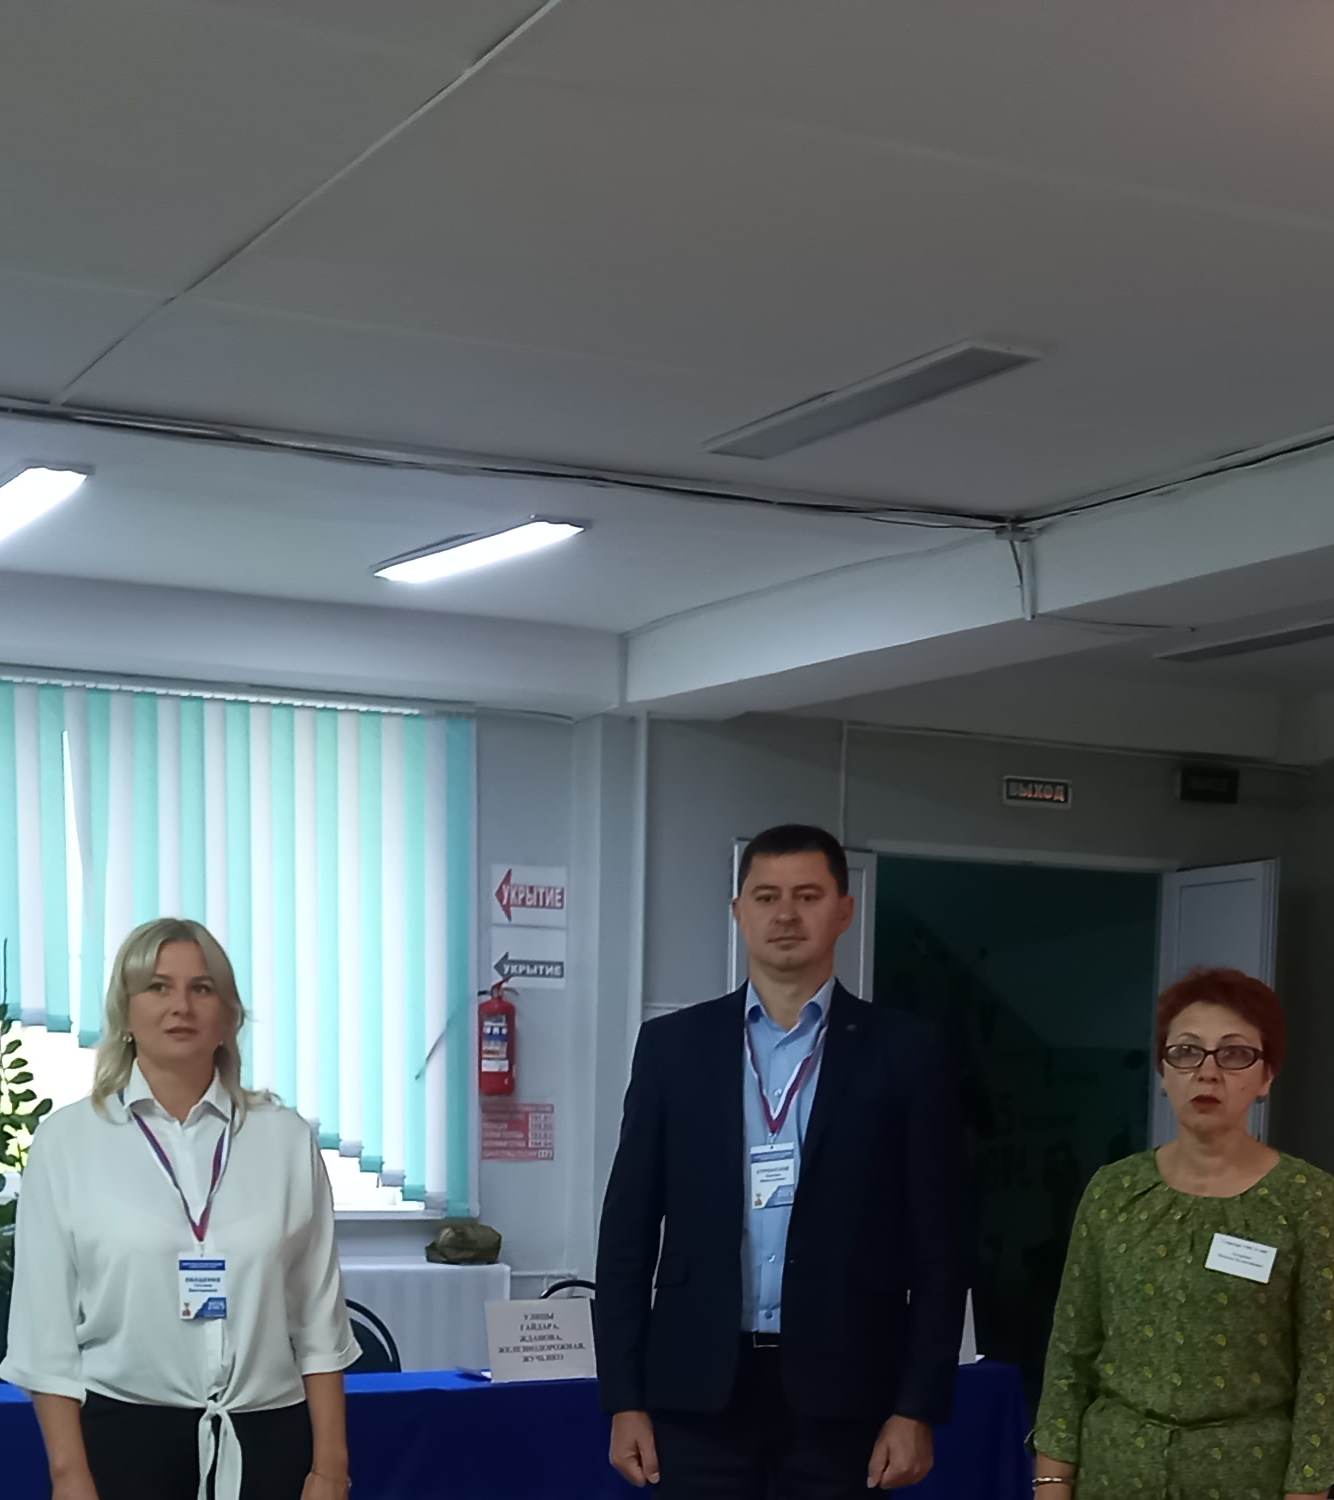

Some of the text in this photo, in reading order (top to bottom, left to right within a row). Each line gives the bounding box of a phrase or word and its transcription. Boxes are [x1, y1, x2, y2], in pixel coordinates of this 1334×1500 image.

[502, 884, 563, 908] УКРЫТИЕ
[503, 963, 562, 977] УКРЫТИЕ
[523, 1312, 554, 1321] УЛИЦЫ
